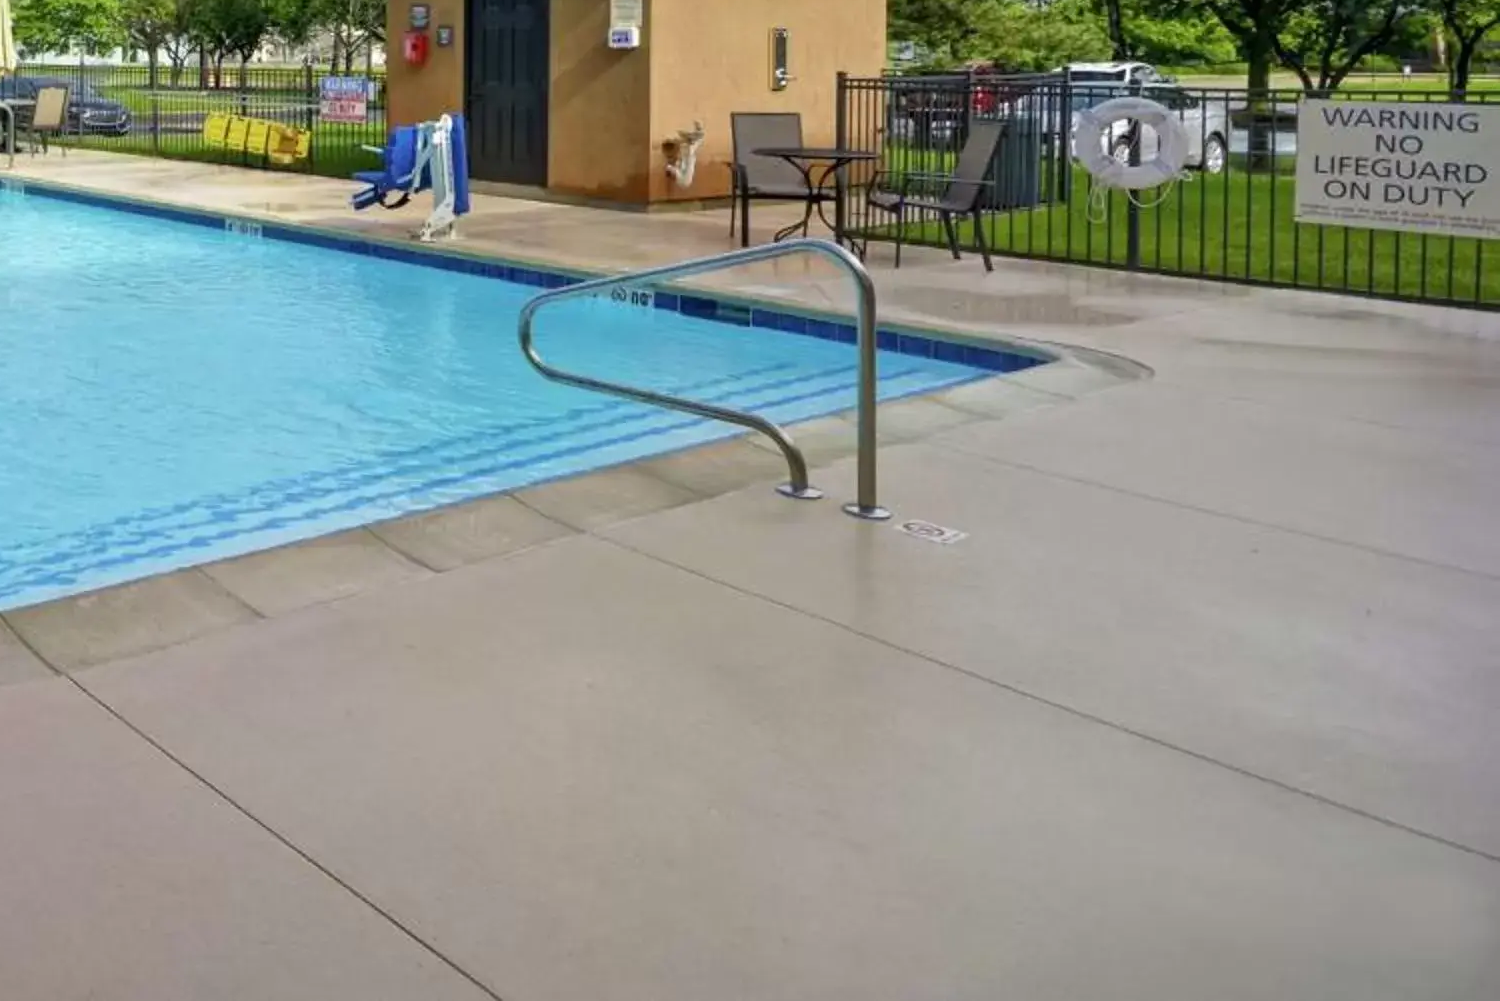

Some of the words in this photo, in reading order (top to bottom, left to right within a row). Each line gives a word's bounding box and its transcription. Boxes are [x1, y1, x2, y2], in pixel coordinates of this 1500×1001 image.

[1322, 107, 1480, 133] WARNING
[1375, 134, 1424, 155] NO
[1314, 154, 1488, 184] LIFEGUARD
[1324, 180, 1371, 201] ON
[1383, 184, 1475, 209] DUTY
